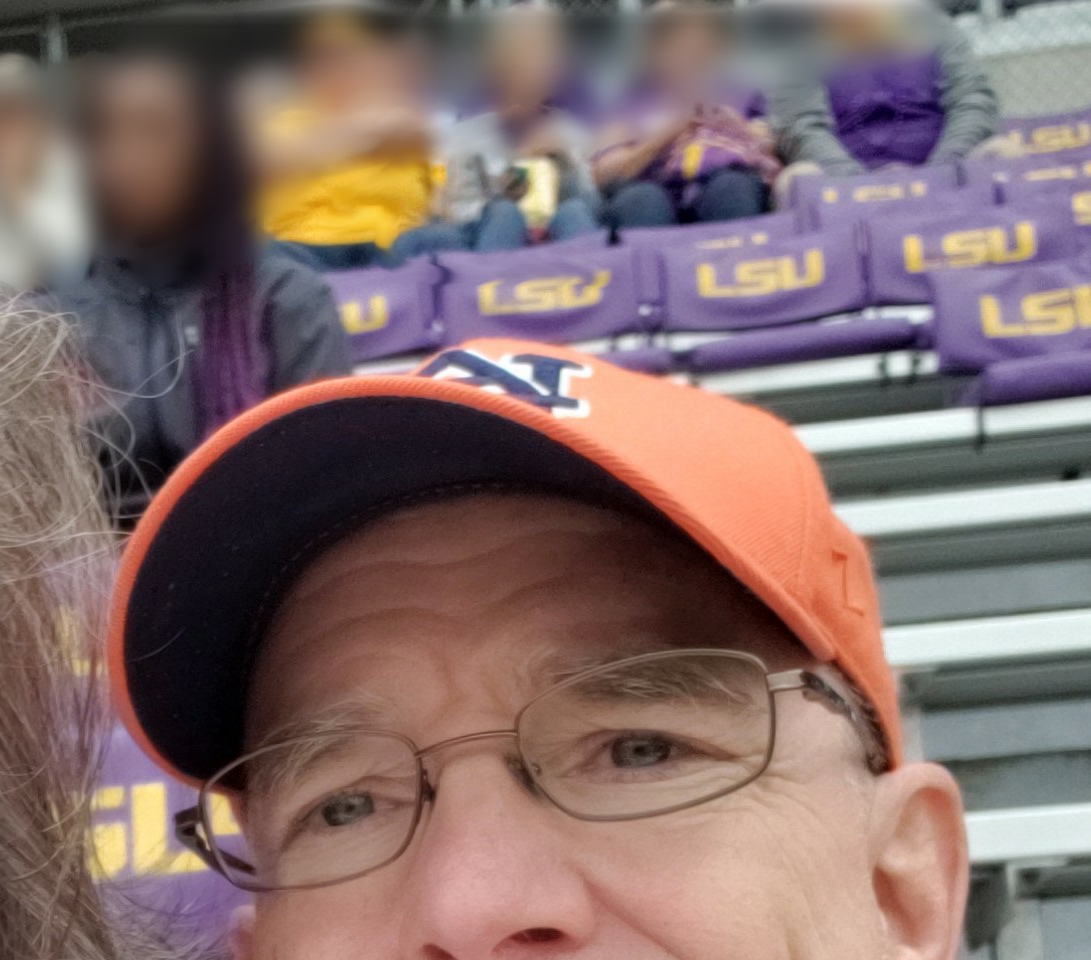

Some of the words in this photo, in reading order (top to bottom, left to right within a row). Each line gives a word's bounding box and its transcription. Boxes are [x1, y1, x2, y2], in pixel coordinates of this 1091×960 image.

[902, 221, 1036, 273] LSU
[478, 269, 611, 314] LSU
[696, 248, 825, 298] LSU
